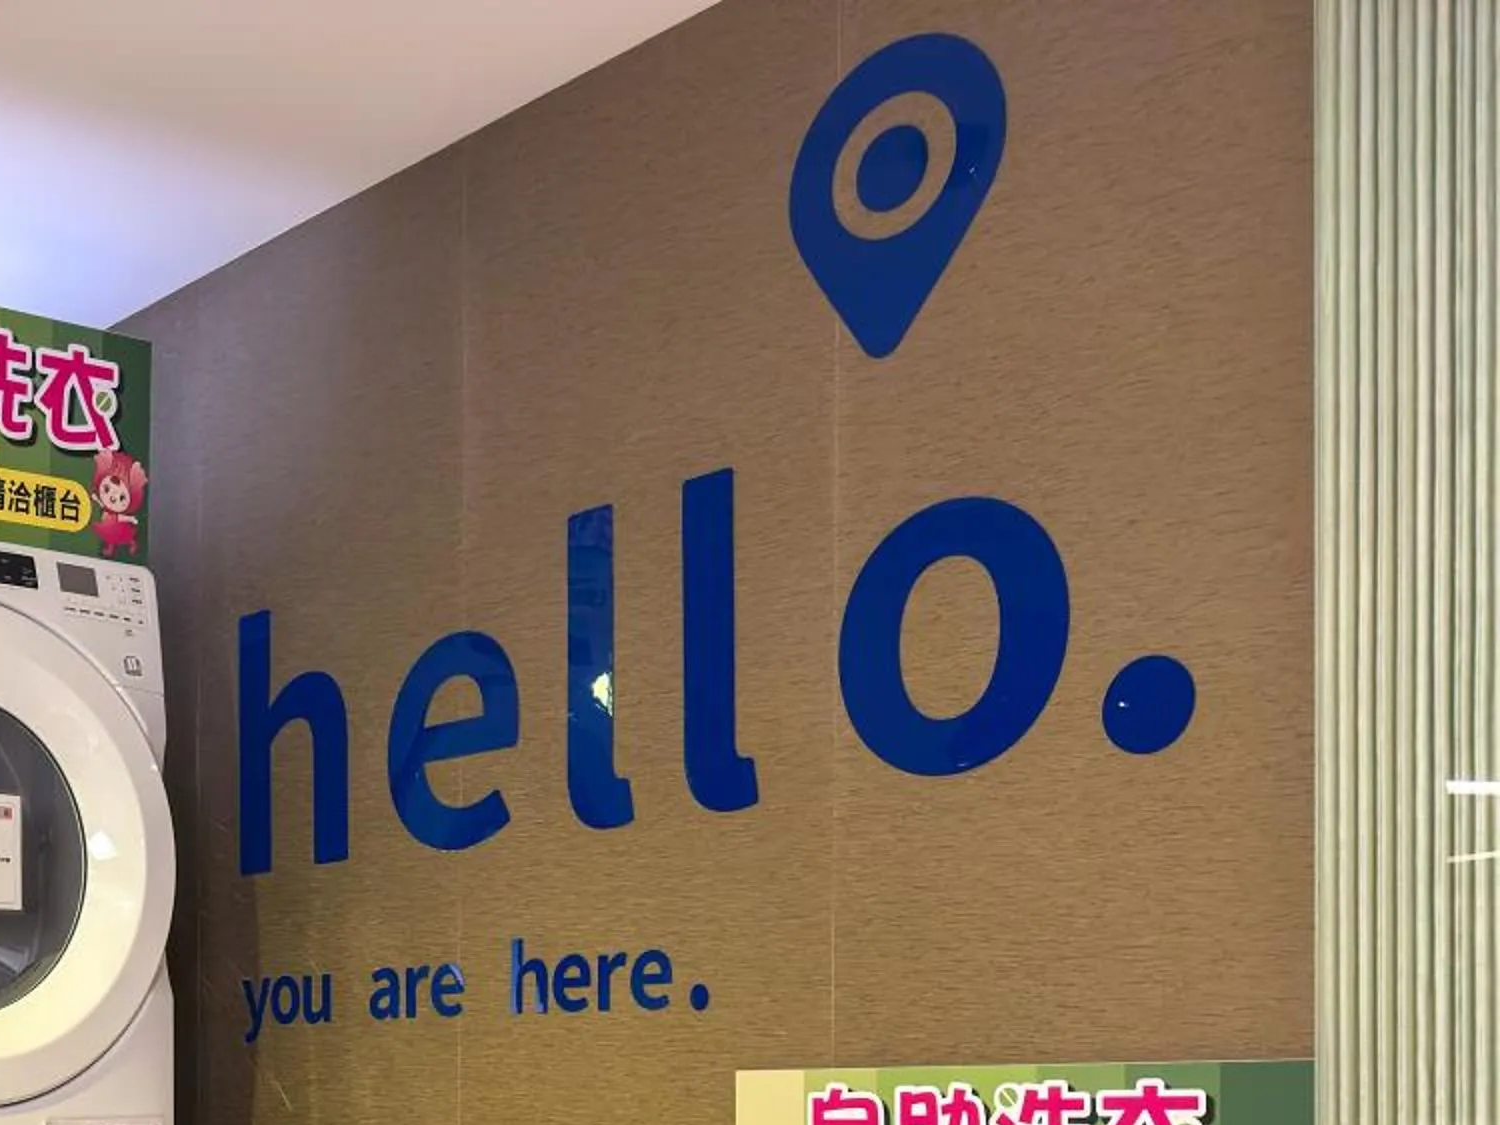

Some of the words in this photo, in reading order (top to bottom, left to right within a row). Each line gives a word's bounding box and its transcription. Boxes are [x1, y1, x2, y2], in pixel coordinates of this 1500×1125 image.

[238, 467, 1197, 876] hello.
[241, 973, 332, 1044] you
[369, 962, 465, 1020] are
[511, 937, 710, 1015] here.
